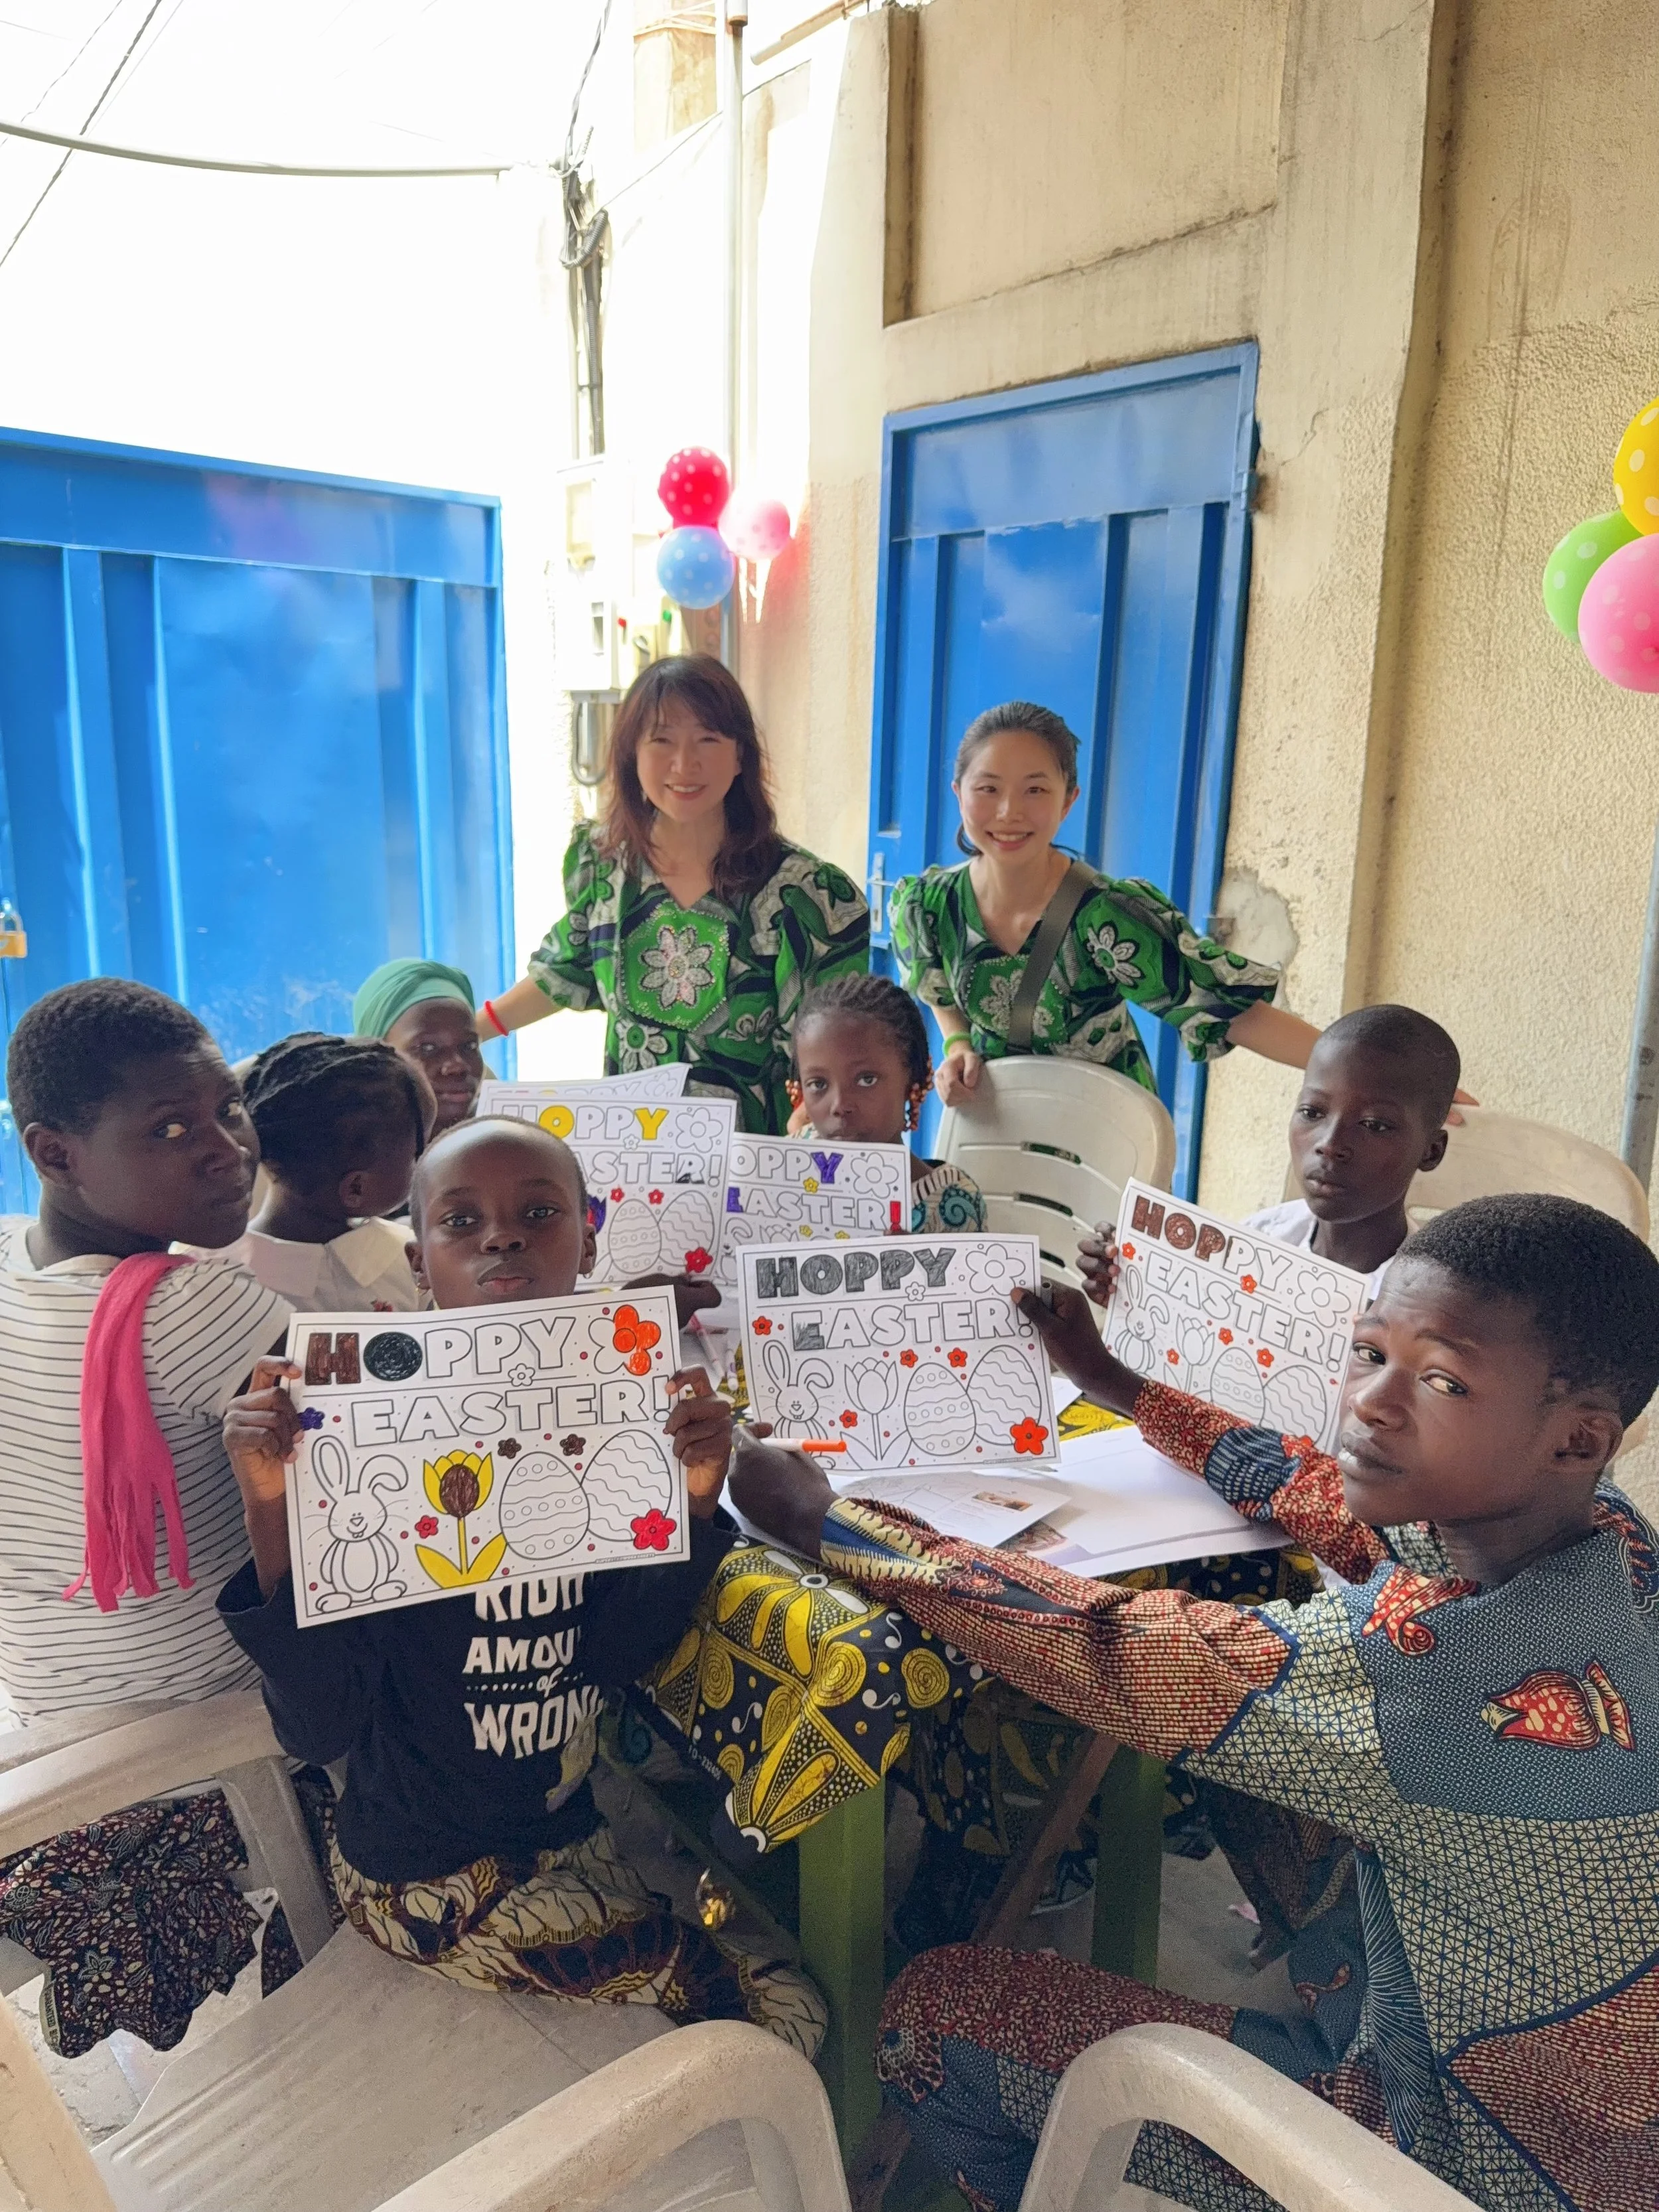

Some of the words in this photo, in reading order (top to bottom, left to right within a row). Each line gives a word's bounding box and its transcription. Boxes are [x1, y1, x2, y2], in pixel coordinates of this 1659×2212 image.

[573, 1151, 723, 1187] STER!
[730, 1143, 844, 1184] OPPY
[1131, 1195, 1292, 1291] HOPPY
[755, 1247, 956, 1299] HOPPY
[790, 1297, 1034, 1352] EASTER!
[1145, 1251, 1346, 1372] EASTER!
[304, 1317, 576, 1386] HOPPY
[351, 1374, 671, 1447] EASTER!
[463, 1625, 581, 1674] AMOU
[536, 1666, 564, 1698] of
